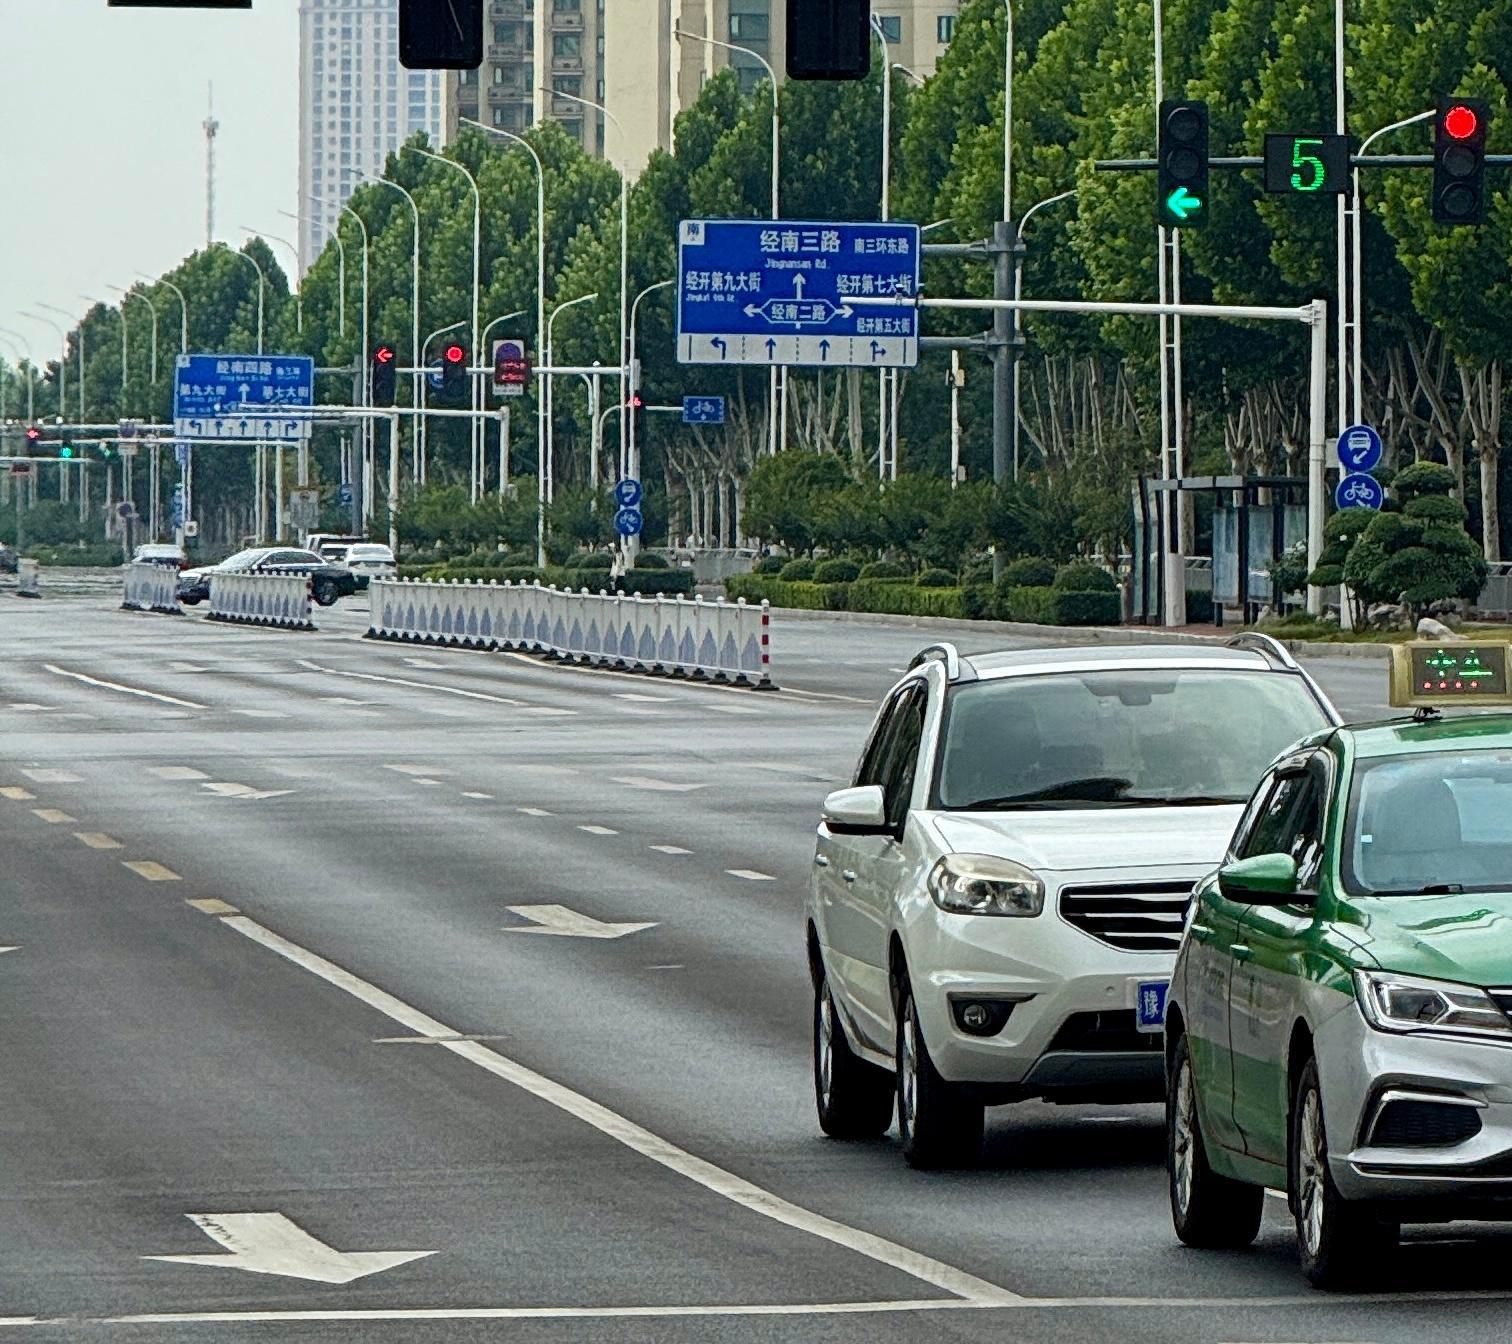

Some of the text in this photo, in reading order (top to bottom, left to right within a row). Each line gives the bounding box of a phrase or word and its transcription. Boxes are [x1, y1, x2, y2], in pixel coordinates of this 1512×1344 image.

[1291, 138, 1324, 191] 5
[760, 230, 840, 253] 经南三路
[854, 237, 909, 254] 南三环东路
[686, 271, 761, 292] 经开第九大街
[837, 274, 912, 295] 经开第七大街
[771, 304, 826, 321] 经南二路
[856, 317, 911, 334] 经开第五大街
